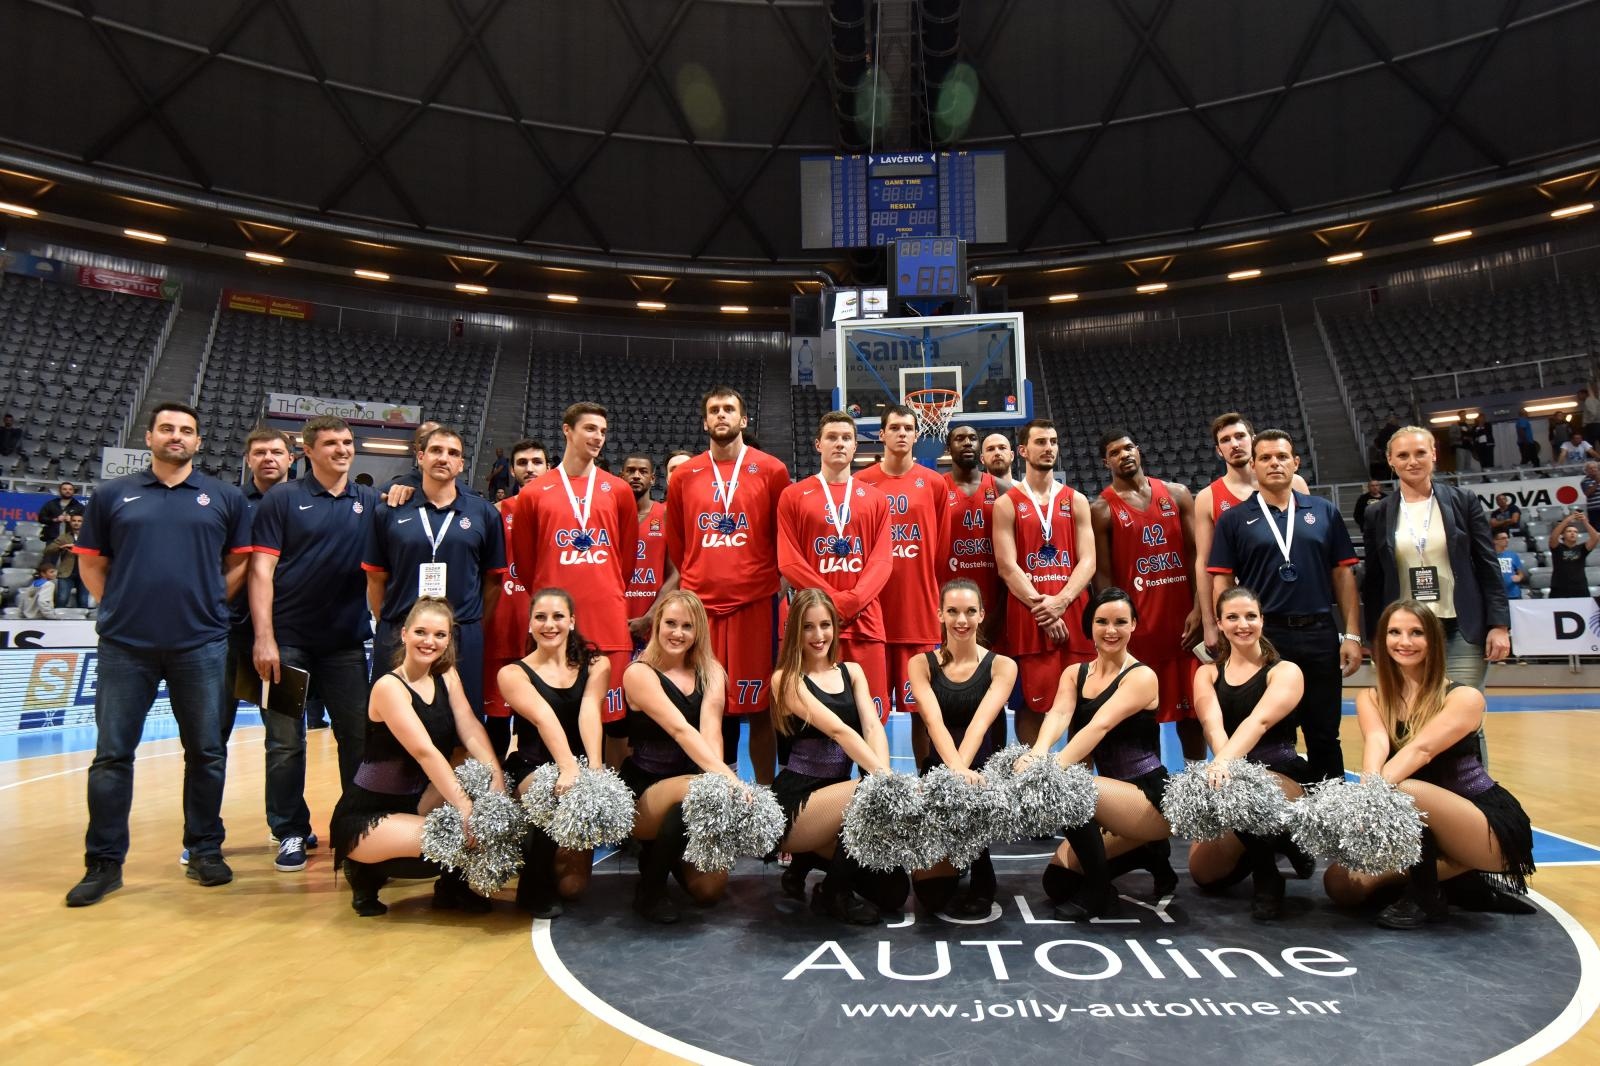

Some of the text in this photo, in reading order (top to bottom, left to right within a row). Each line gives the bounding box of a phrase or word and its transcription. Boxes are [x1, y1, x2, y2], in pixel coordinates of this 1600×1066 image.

[712, 480, 739, 502] 7
[886, 494, 908, 514] 20
[963, 509, 984, 530] 44
[701, 532, 748, 547] UAC
[1142, 523, 1167, 547] 42
[560, 550, 608, 565] UAC
[953, 538, 992, 556] CSKA
[820, 557, 863, 574] UAC
[1136, 551, 1182, 574] CSKA
[606, 686, 622, 713] 11
[737, 680, 762, 704] 77
[781, 938, 1358, 981] AUTOline
[841, 997, 1341, 1022] www.jolly-autoline.hr
